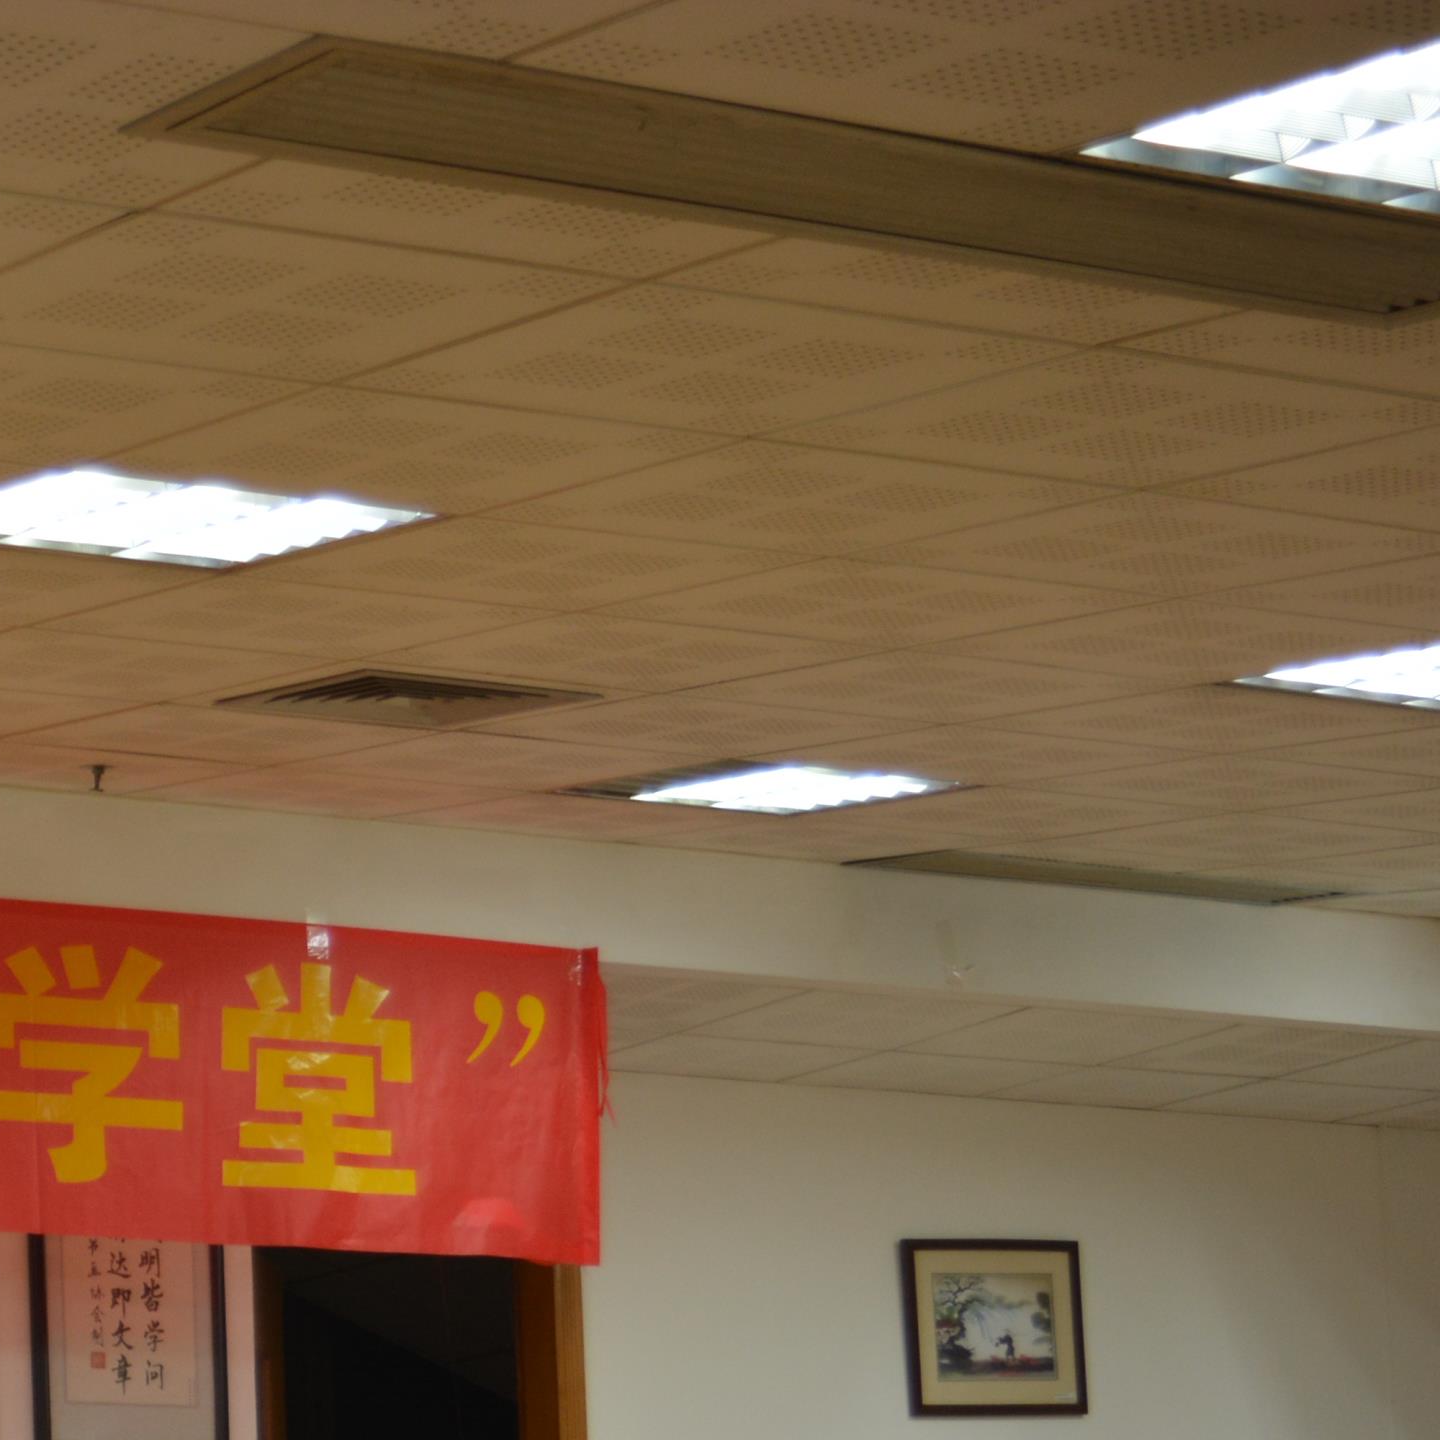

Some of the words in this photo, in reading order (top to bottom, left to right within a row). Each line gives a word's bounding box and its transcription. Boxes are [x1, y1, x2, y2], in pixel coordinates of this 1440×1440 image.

[108, 1238, 133, 1396] 达即文章
[139, 1240, 165, 1391] 明皆学问
